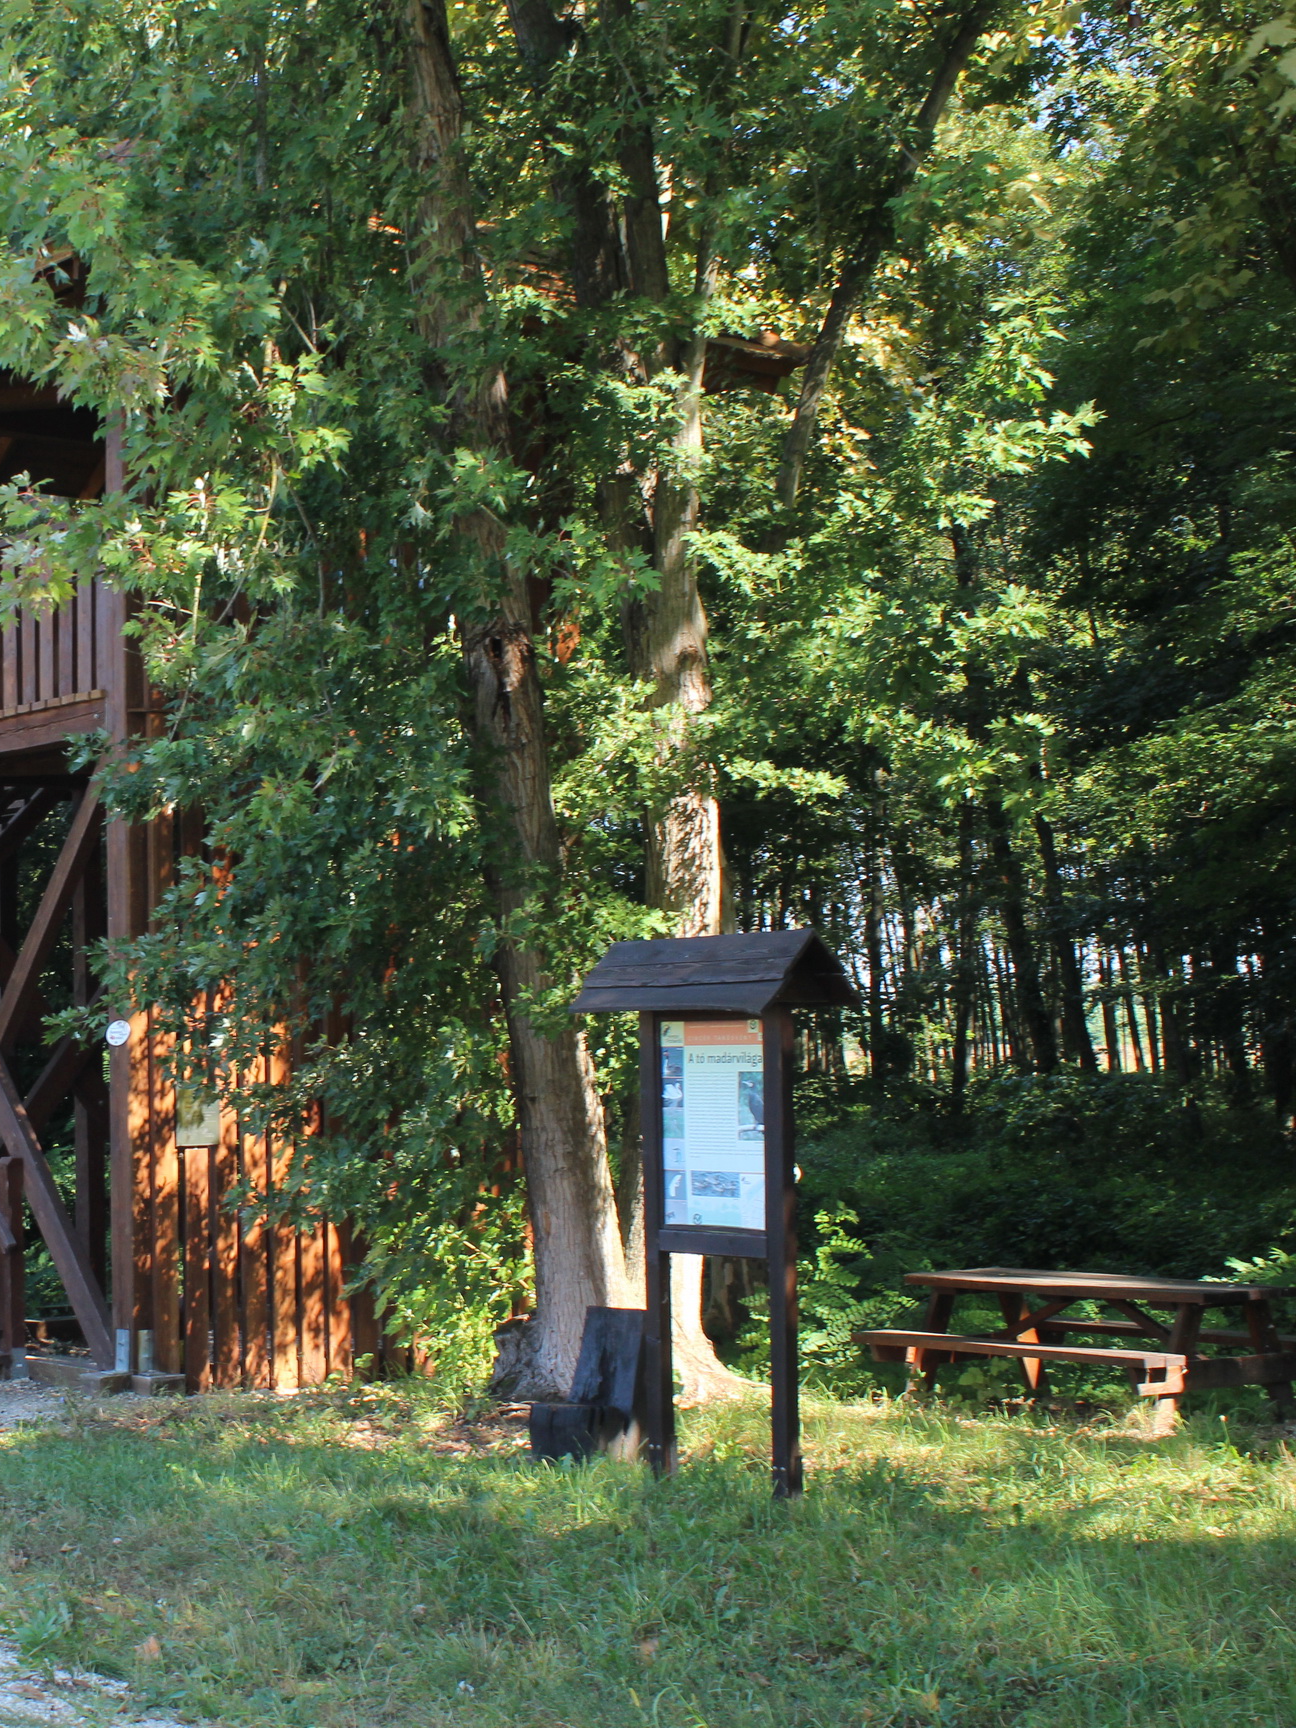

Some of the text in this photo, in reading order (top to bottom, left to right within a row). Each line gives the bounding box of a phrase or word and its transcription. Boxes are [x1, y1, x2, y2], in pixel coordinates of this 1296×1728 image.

[688, 1051, 763, 1067] A tó madárvilága
